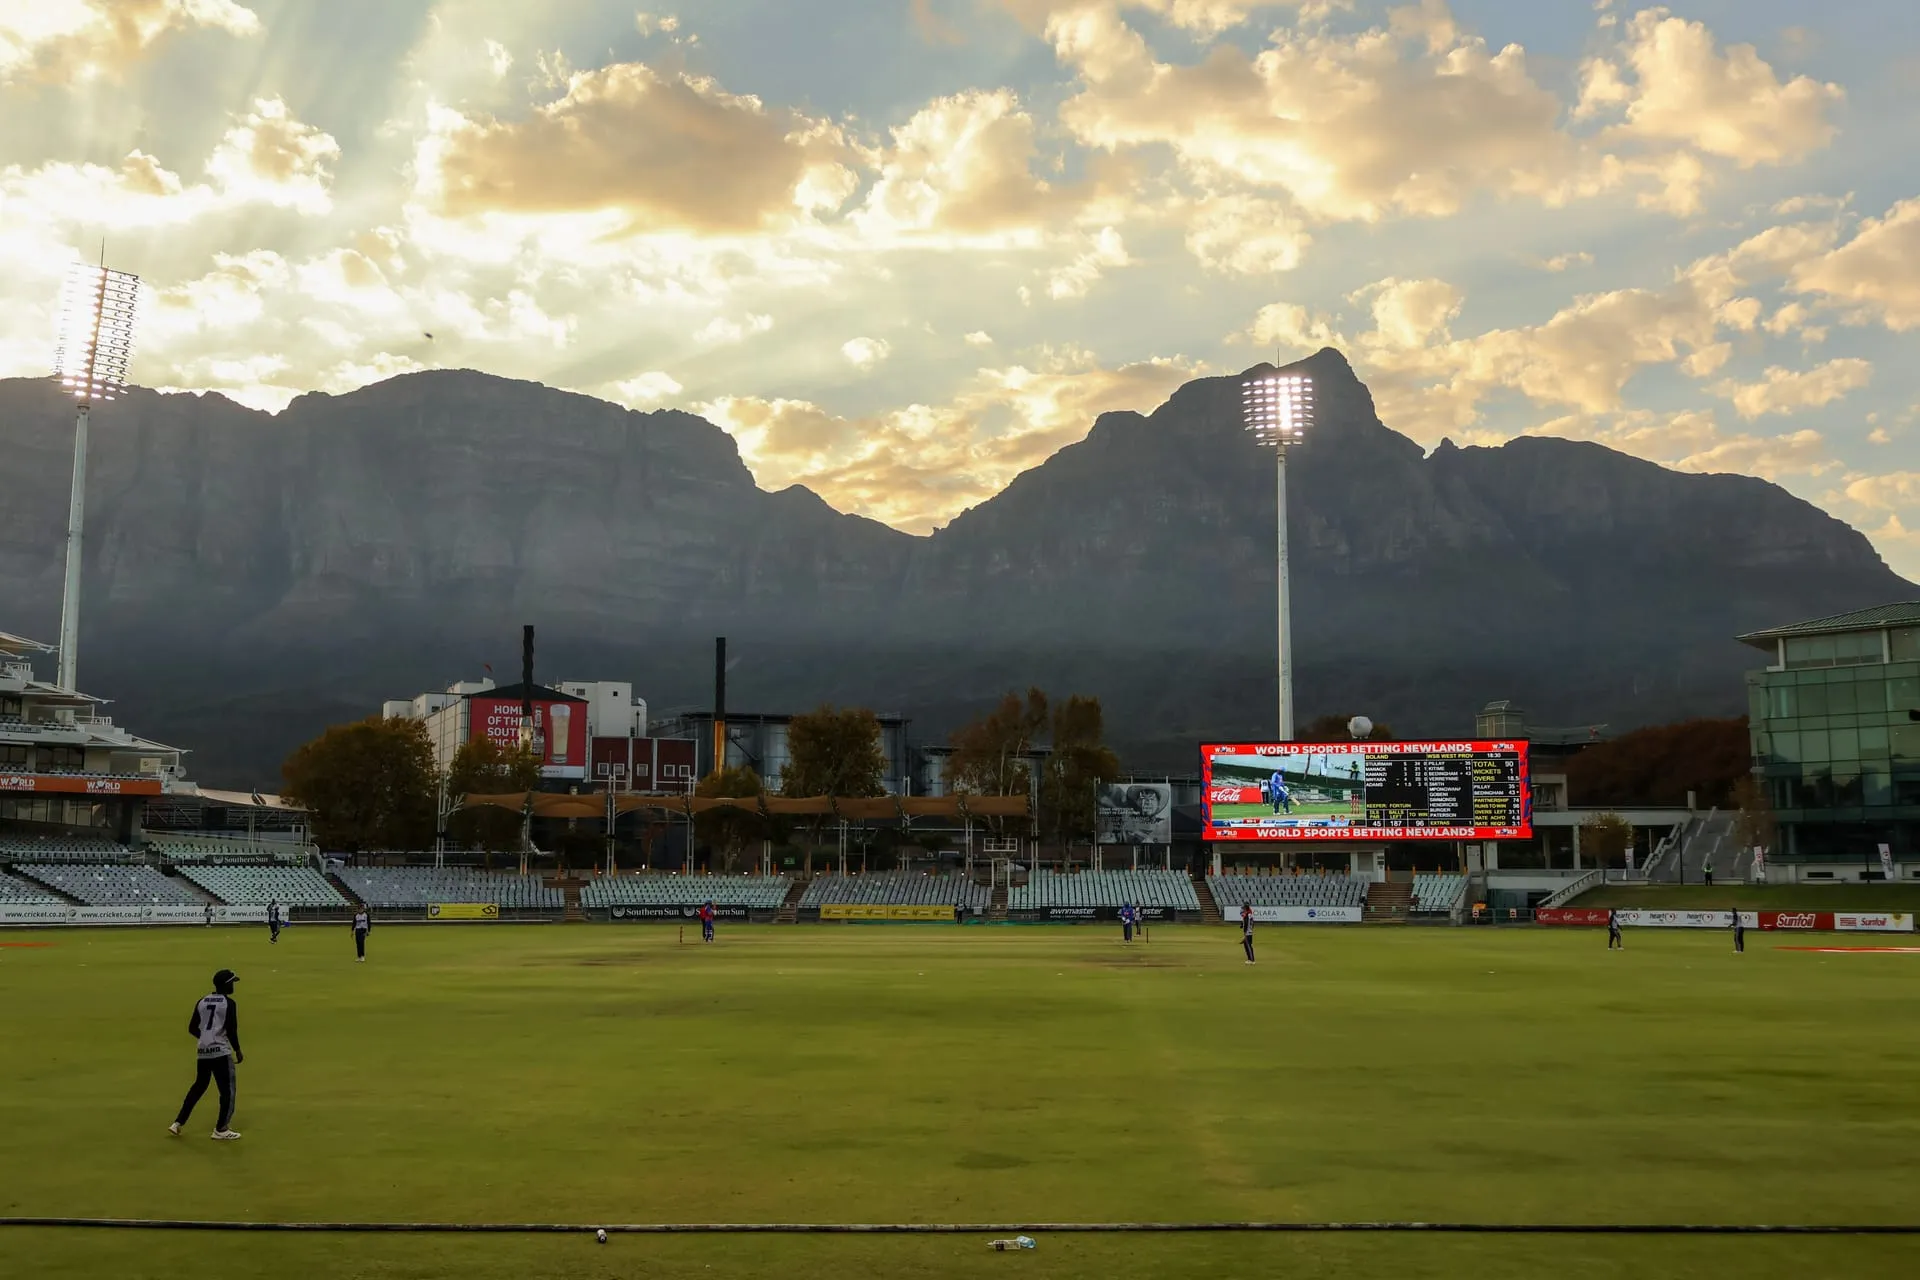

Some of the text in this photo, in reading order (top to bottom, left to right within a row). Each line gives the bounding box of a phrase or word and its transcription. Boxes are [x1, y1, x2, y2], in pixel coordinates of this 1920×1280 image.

[488, 716, 521, 725] OF TH
[488, 728, 520, 736] SOUT
[1255, 743, 1473, 754] WORLD SPORTS BETTING NEWLANDS
[1256, 828, 1475, 838] WORLD SPORTS BETTING NEWLANDS
[224, 855, 269, 863] Southern Sun
[5, 910, 66, 919] www.cricket.co.za
[81, 910, 142, 919] www.cricket.co.za
[626, 907, 680, 916] Southern Sun
[731, 907, 745, 916] Sun
[1776, 914, 1816, 928] Sunfoil
[1860, 918, 1887, 926] Sunfoil
[206, 1005, 216, 1030] 7
